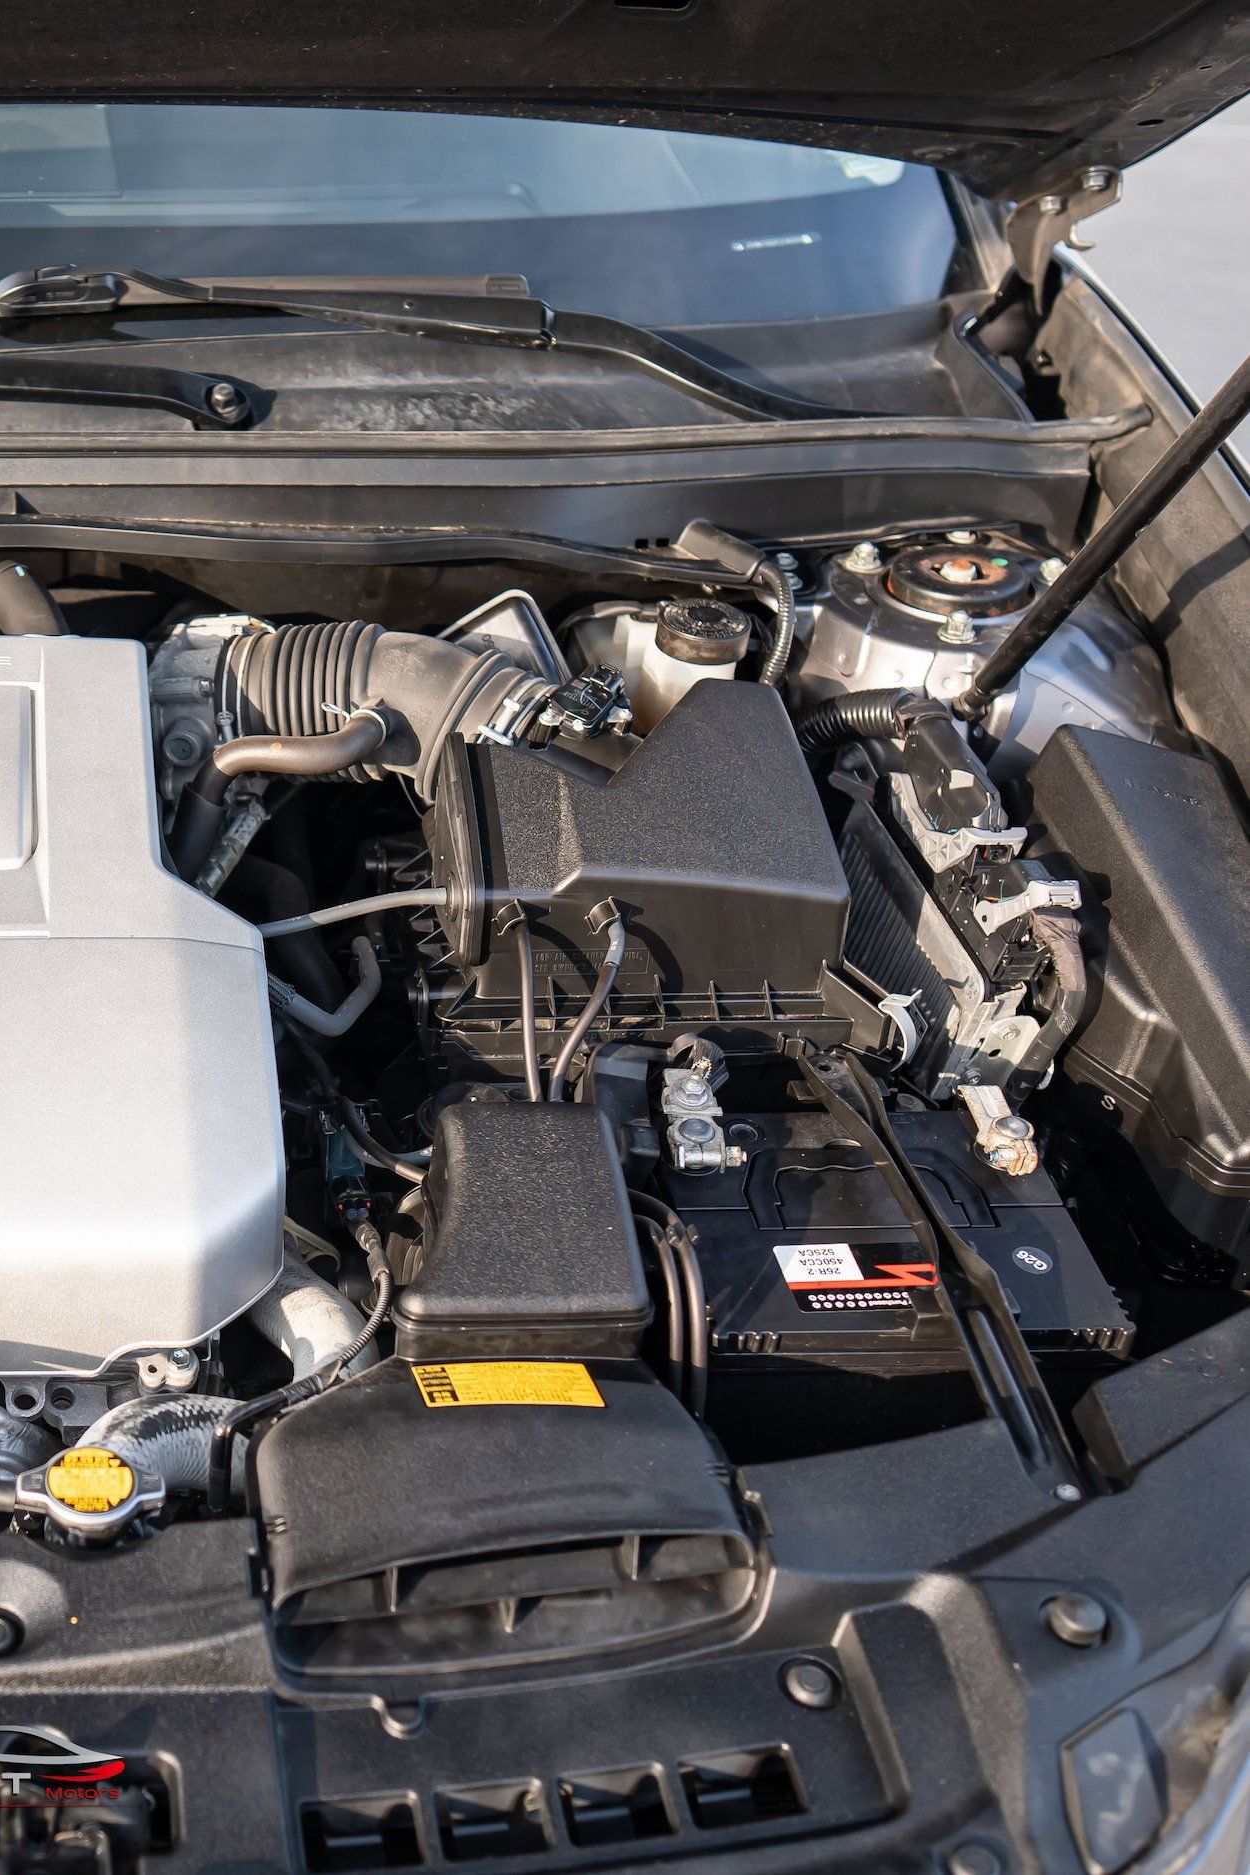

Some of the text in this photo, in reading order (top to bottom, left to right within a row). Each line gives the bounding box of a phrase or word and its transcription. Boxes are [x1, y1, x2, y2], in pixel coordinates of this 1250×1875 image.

[797, 1247, 836, 1258] 525CA
[797, 1257, 844, 1267] 450CCA
[1015, 1249, 1049, 1271] G26
[805, 1267, 842, 1277] 26R-2
[867, 1298, 909, 1308] Purchased
